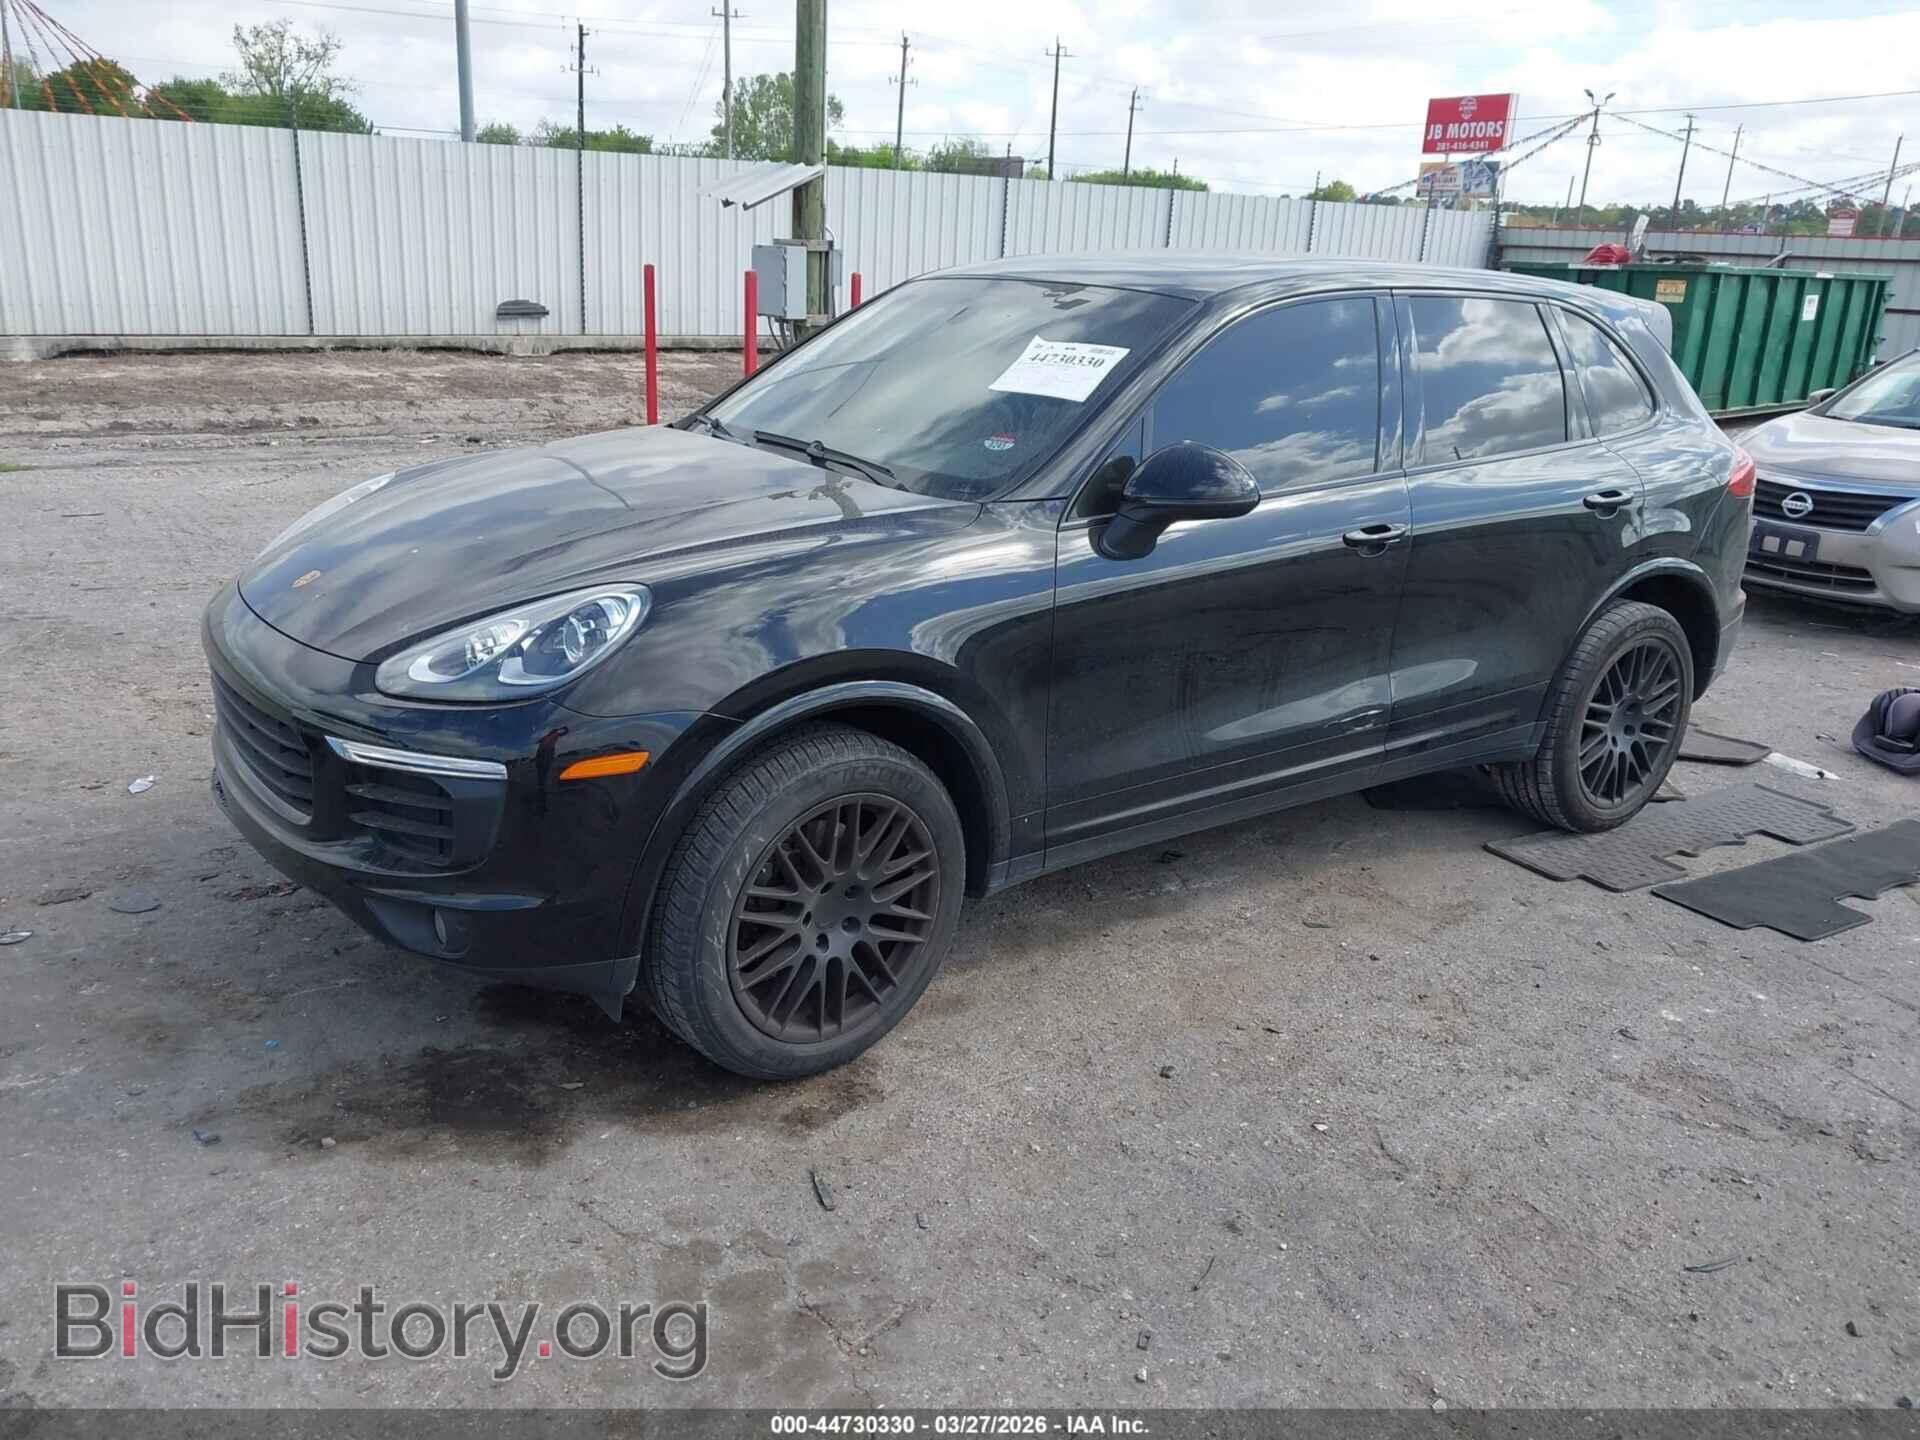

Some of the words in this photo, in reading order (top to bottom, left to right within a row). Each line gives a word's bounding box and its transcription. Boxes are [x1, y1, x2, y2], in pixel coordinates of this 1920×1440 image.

[1427, 124, 1443, 140] JB
[1446, 120, 1504, 139] MOTORS
[1029, 352, 1105, 369] 44730330
